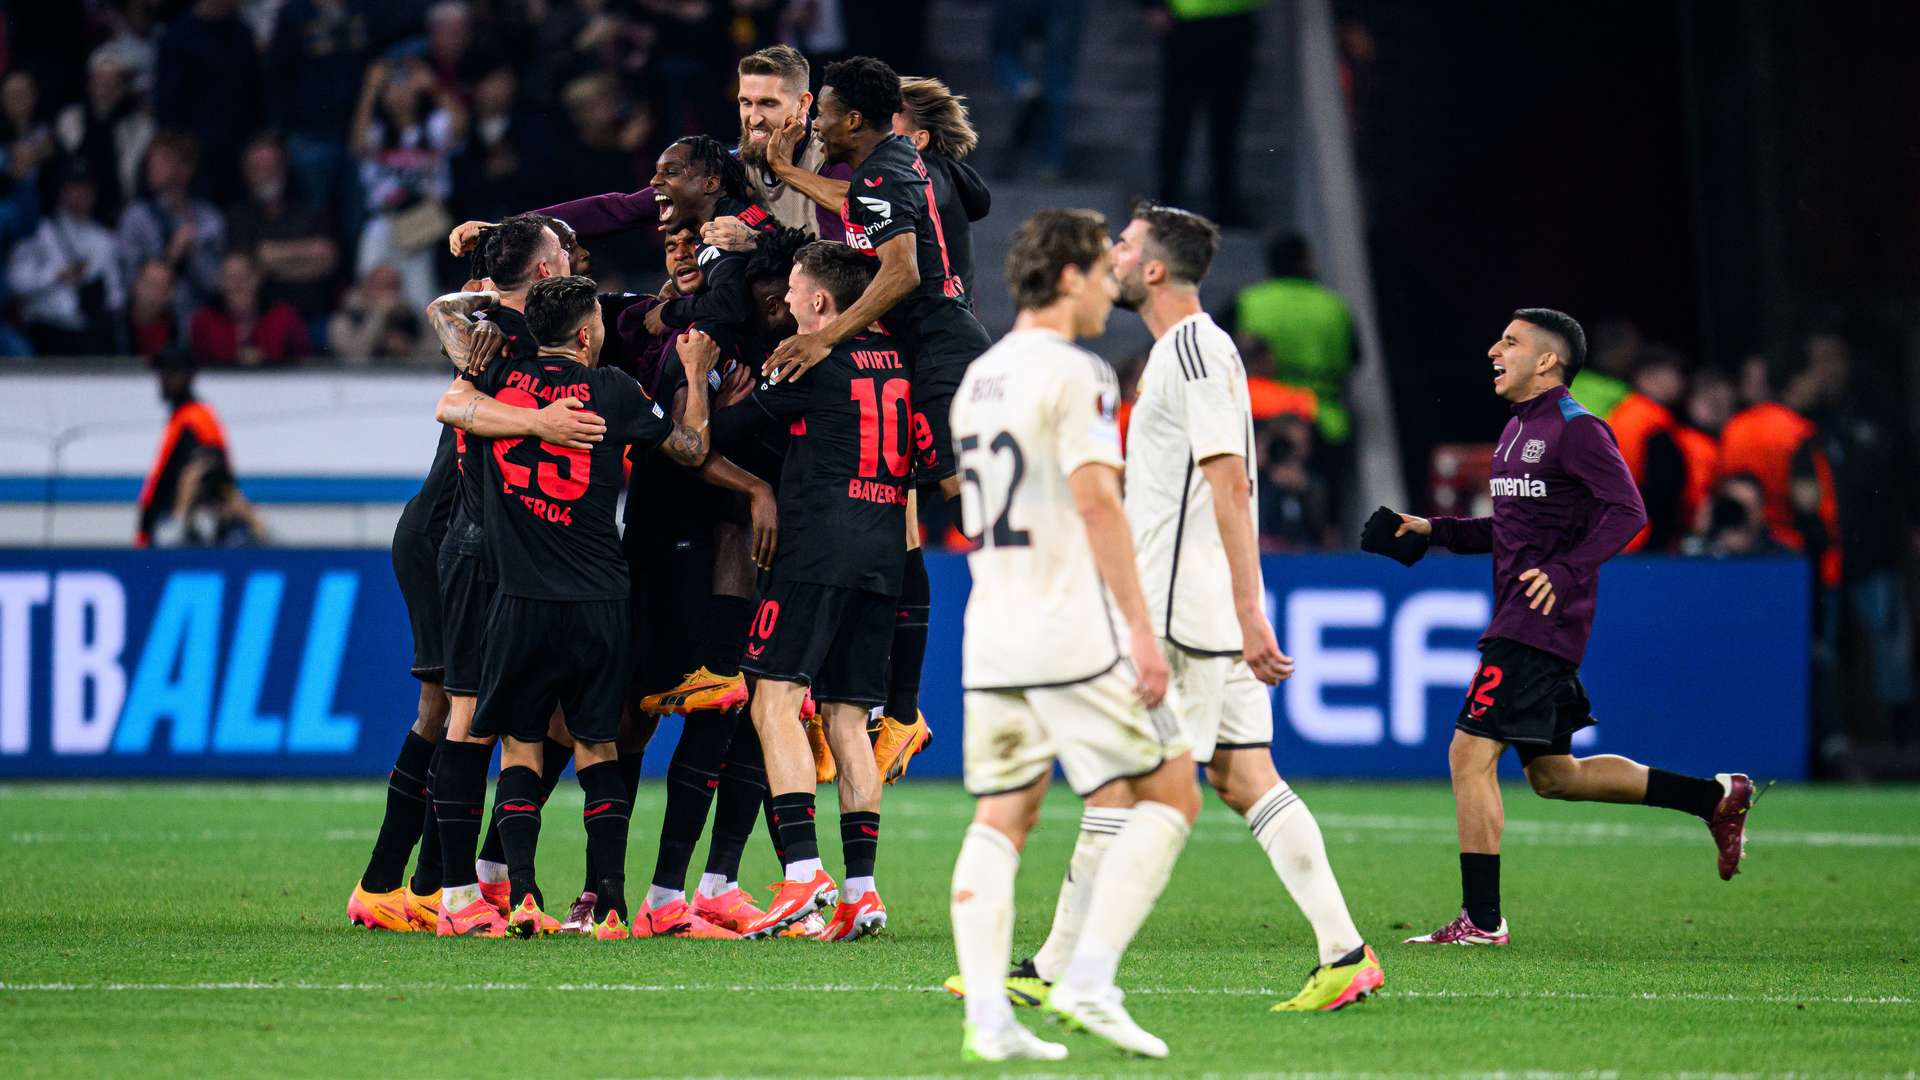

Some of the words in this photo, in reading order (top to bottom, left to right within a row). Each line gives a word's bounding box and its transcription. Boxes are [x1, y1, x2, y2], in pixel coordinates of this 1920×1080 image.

[863, 218, 893, 236] trive
[850, 350, 902, 370] WIRTZ
[493, 387, 593, 501] 25
[851, 377, 912, 478] 10
[955, 431, 1030, 549] 52
[0, 570, 361, 755] TBALL
